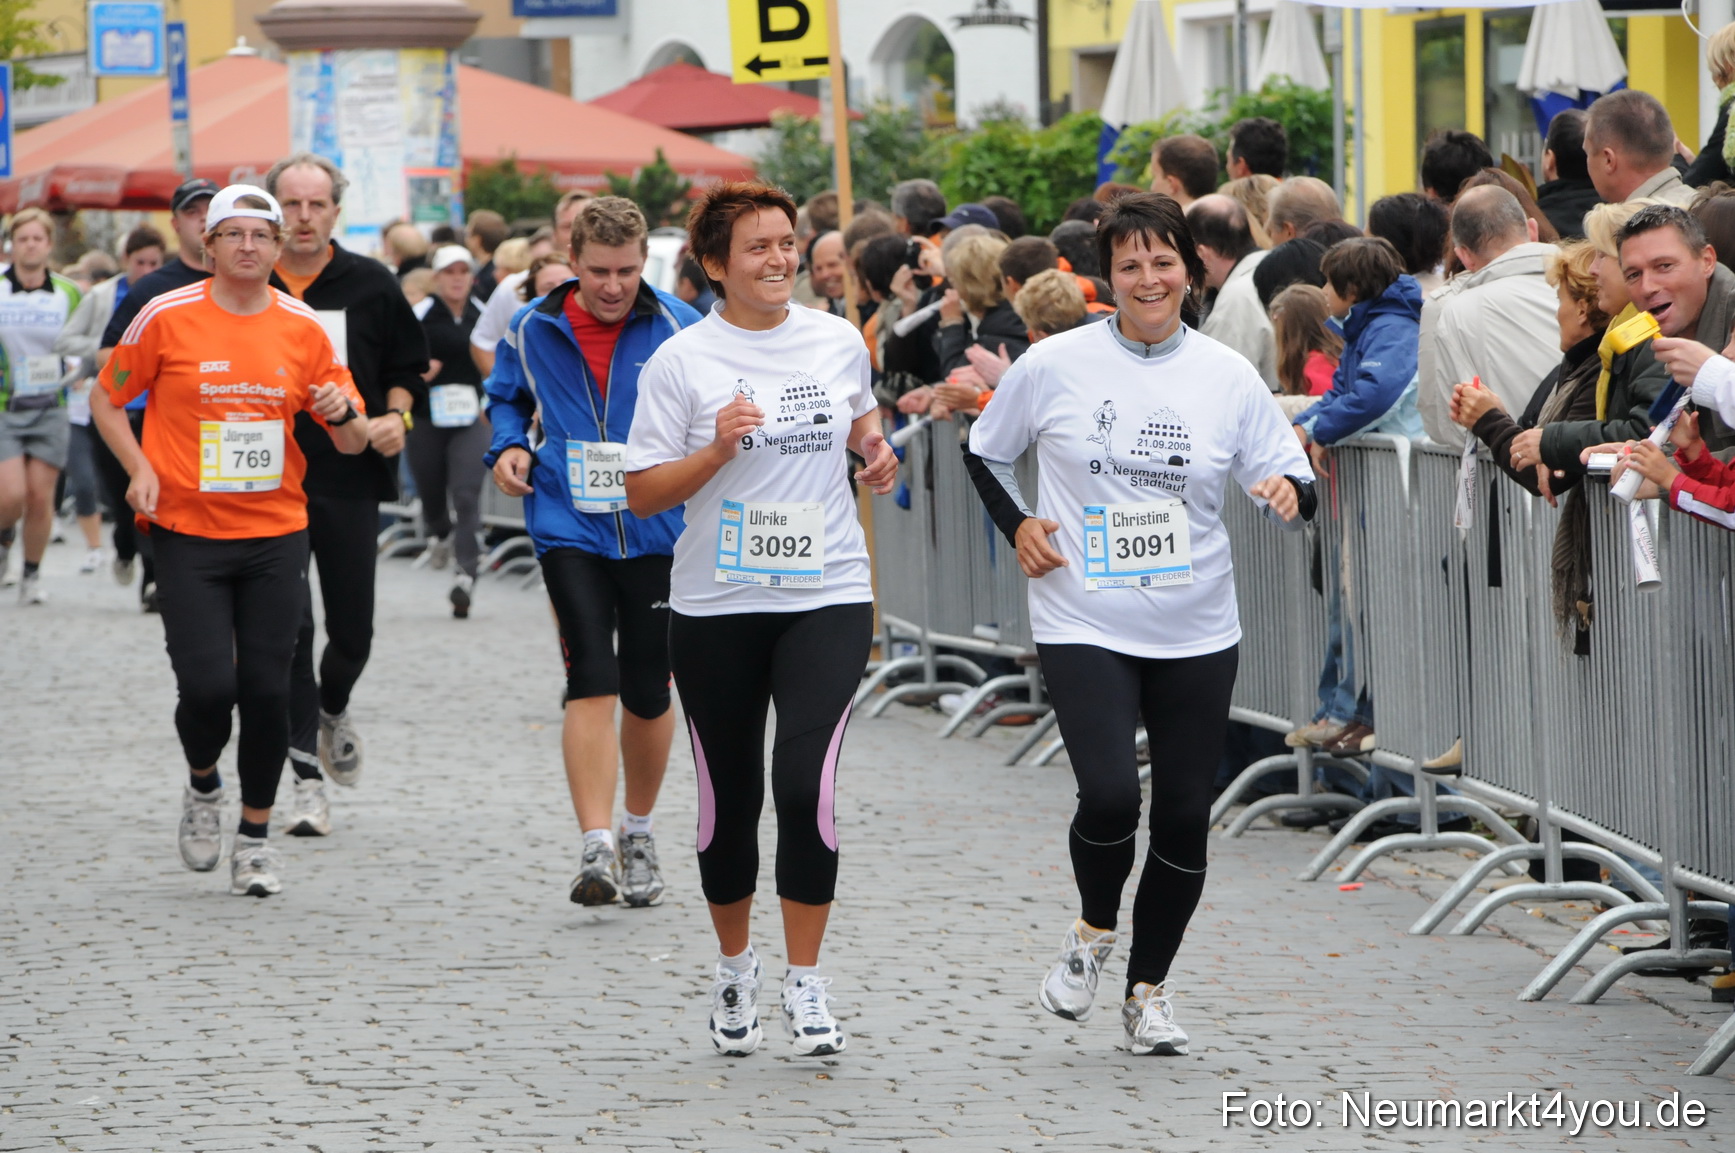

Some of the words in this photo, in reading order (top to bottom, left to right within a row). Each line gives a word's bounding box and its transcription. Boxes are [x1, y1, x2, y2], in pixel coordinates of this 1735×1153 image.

[199, 361, 231, 373] DAK
[199, 382, 287, 398] SportScheck
[780, 399, 831, 413] 21.09.2008
[223, 429, 263, 444] Jürgen
[741, 435, 760, 450] 9.
[764, 431, 833, 447] Neumarkter
[780, 440, 833, 455] Stadtlauf
[1137, 438, 1191, 451] 21.09.2008
[233, 449, 271, 469] 769
[586, 449, 622, 462] Robert
[1089, 459, 1109, 475] 9.
[1113, 465, 1188, 482] Neumarkter
[589, 470, 626, 487] 230
[1130, 476, 1187, 493] Stadtlauf
[749, 510, 788, 526] Ulrike
[1112, 511, 1170, 527] Christine
[725, 530, 732, 541] C
[1091, 537, 1097, 548] C
[749, 535, 812, 558] 3092
[1115, 532, 1175, 559] 3091
[782, 575, 821, 583] PFLEIDERER
[1151, 571, 1191, 581] PFLEIDERER
